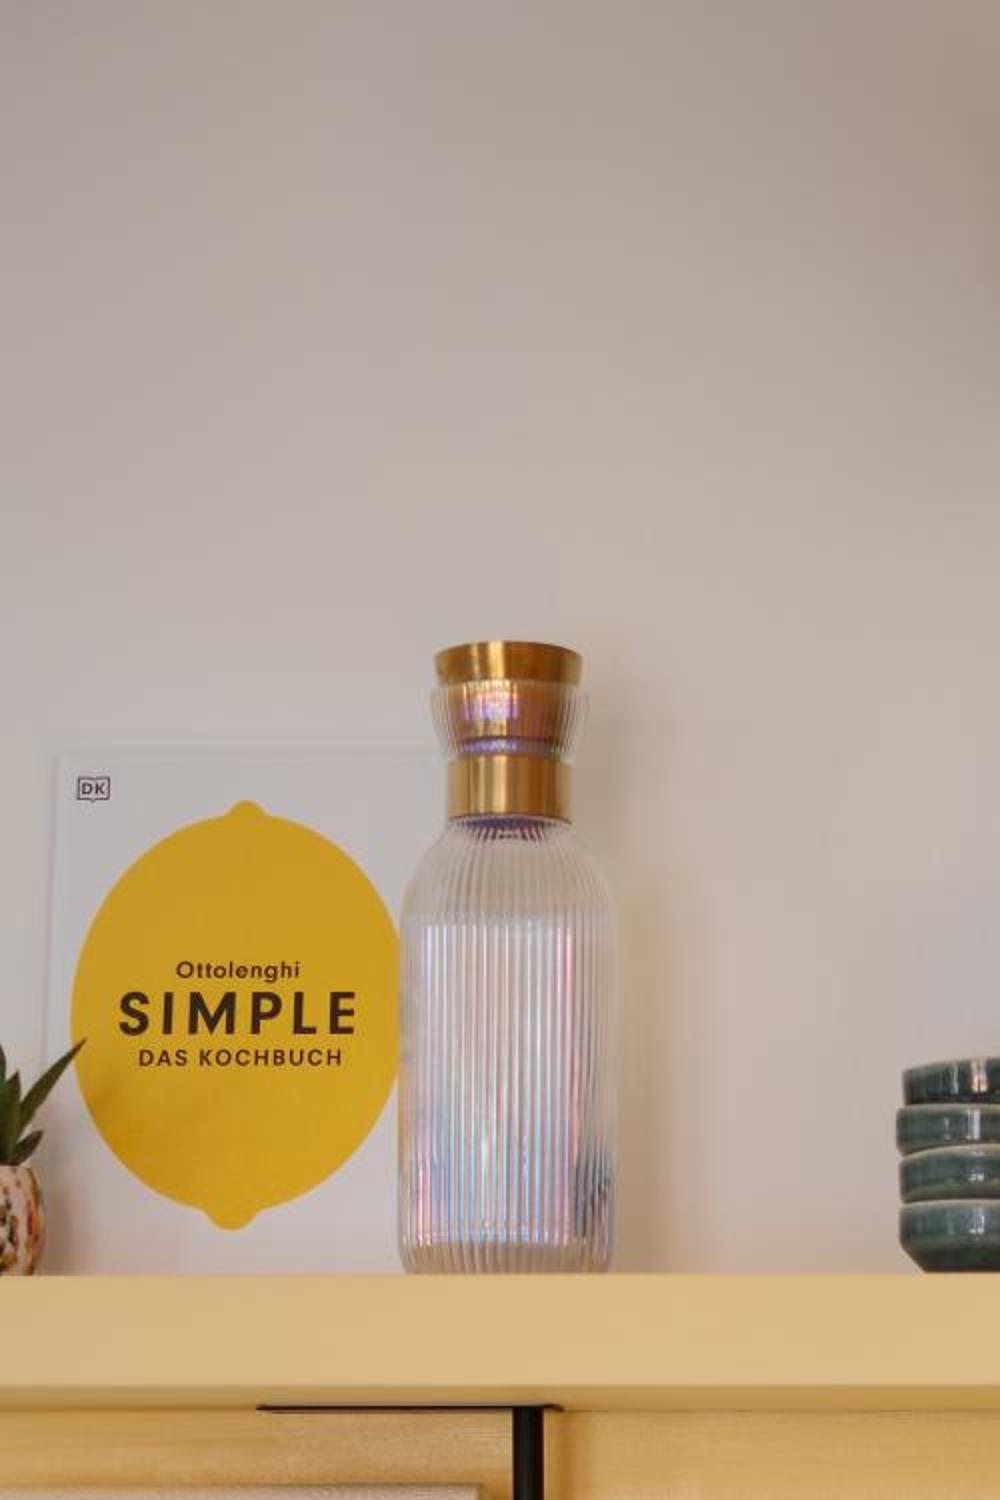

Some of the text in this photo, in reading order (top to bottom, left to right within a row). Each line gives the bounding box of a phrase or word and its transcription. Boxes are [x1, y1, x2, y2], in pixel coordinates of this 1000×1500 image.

[81, 782, 105, 796] DK
[176, 961, 300, 983] Ottolenghi
[118, 992, 356, 1036] SIMPLE
[138, 1049, 342, 1067] DAS KOCHBUCH
